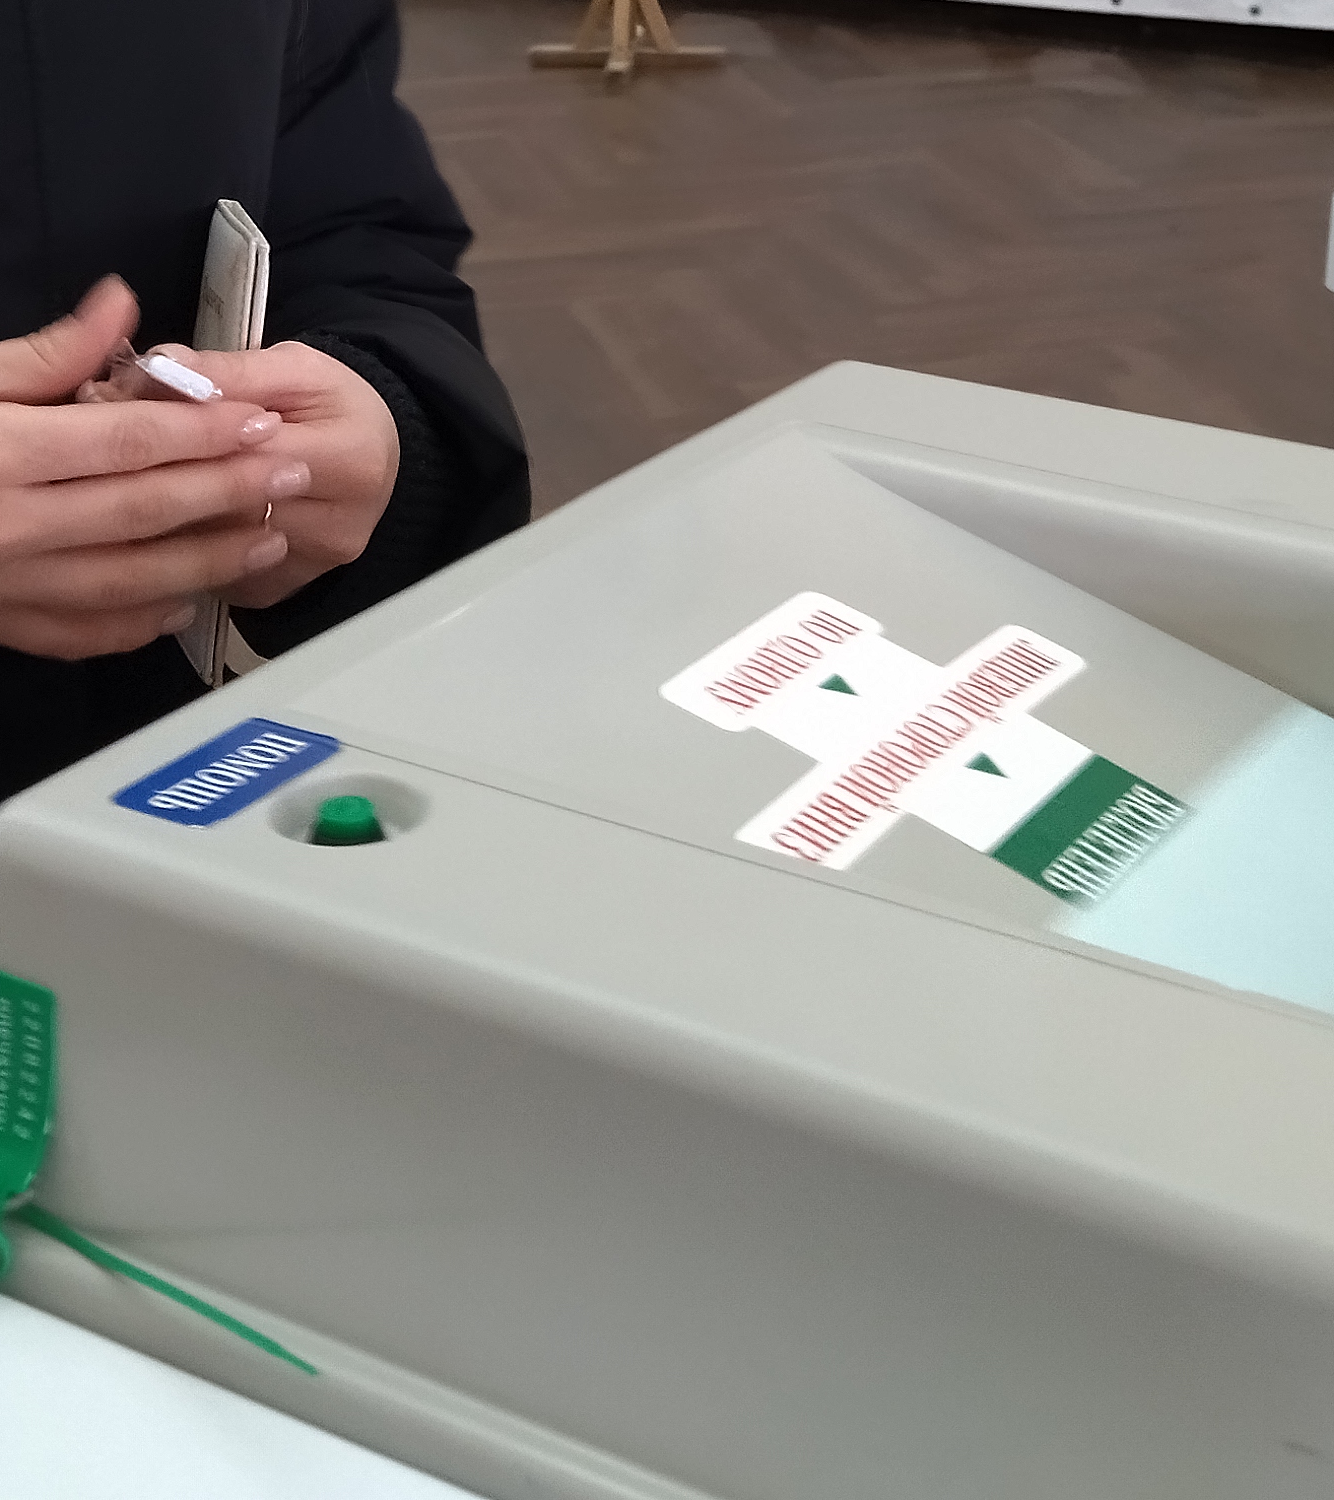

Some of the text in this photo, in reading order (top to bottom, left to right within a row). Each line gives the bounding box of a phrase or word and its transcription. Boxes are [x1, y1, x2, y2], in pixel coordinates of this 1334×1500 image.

[704, 609, 862, 715] ПО ОДНОМУ
[146, 732, 309, 812] ПОМОЩЬ
[771, 639, 1060, 865] ЛИЦЕВОЙ СТОРОНОЙ ВНИЗ
[1041, 783, 1186, 902] БЮЛЛЕТЕНЬ
